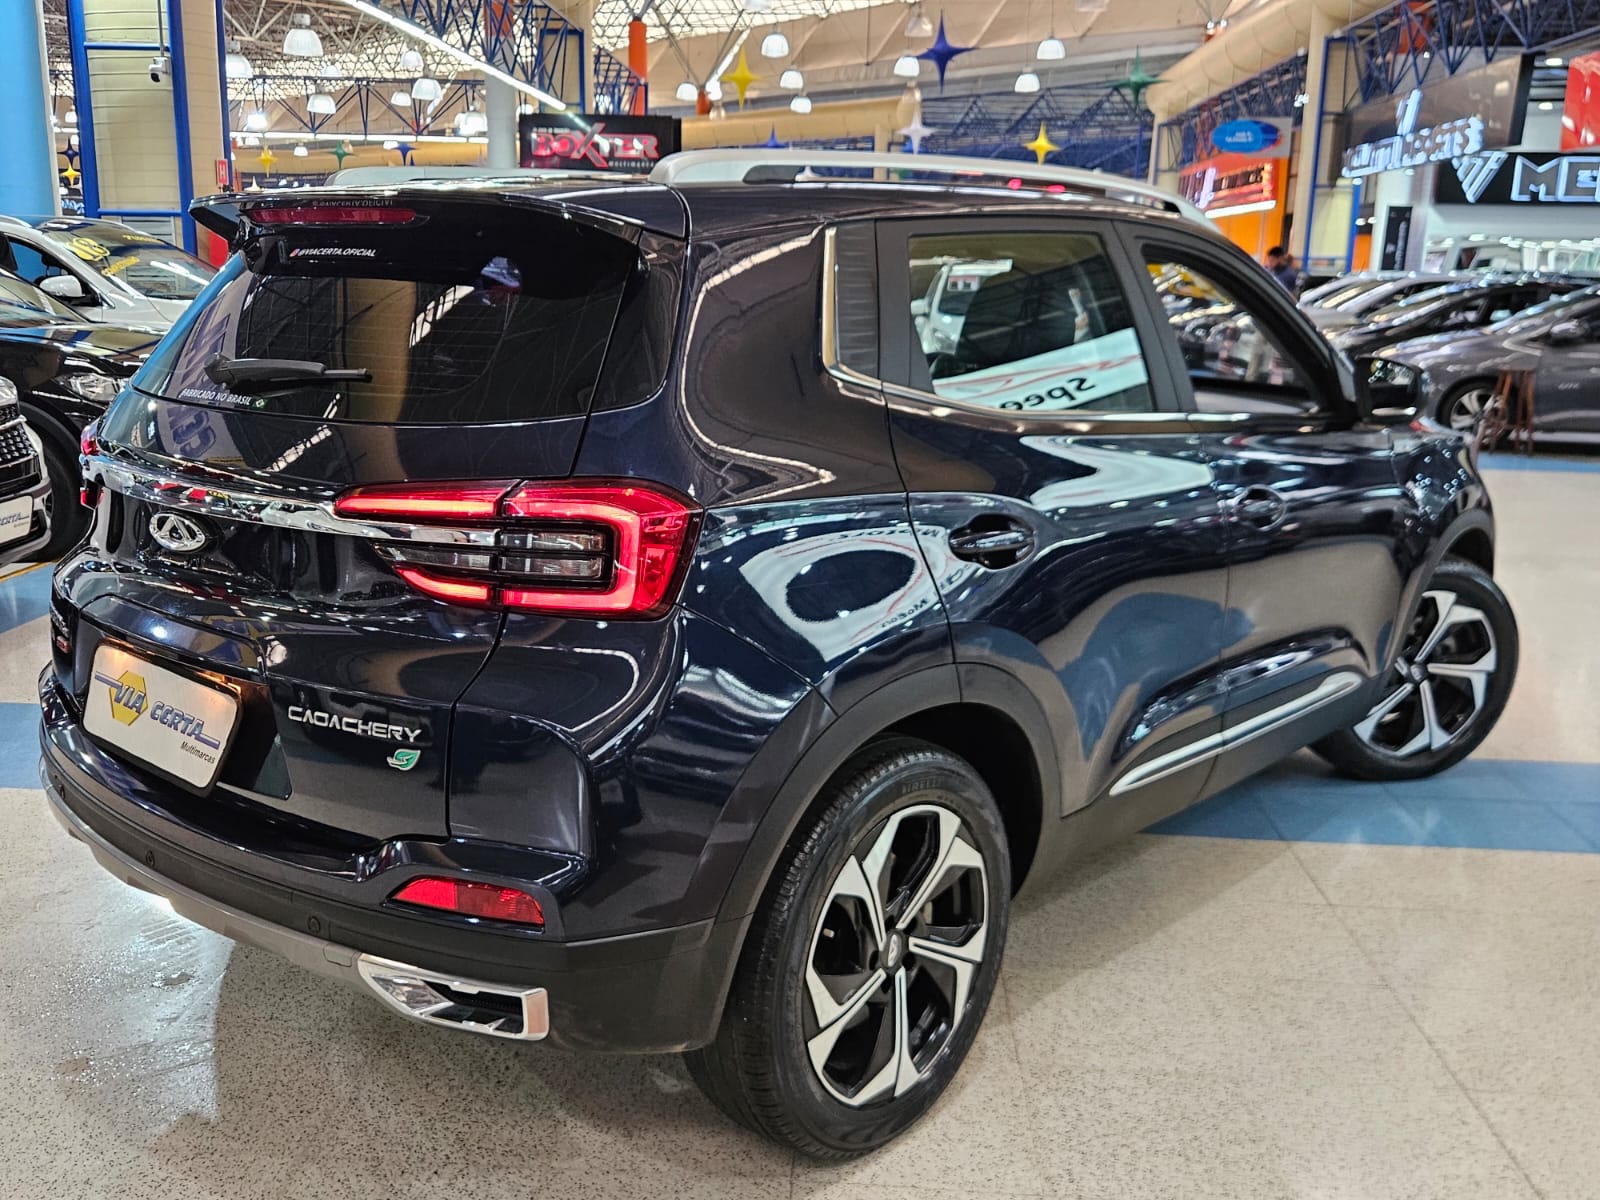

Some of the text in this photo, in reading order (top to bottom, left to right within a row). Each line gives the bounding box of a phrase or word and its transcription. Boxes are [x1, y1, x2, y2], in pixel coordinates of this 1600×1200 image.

[531, 122, 659, 168] BOXTER
[178, 387, 252, 406] FABRICADO NO BRASIL
[113, 682, 205, 738] VIA CERTA
[180, 740, 216, 765] Multimarcas
